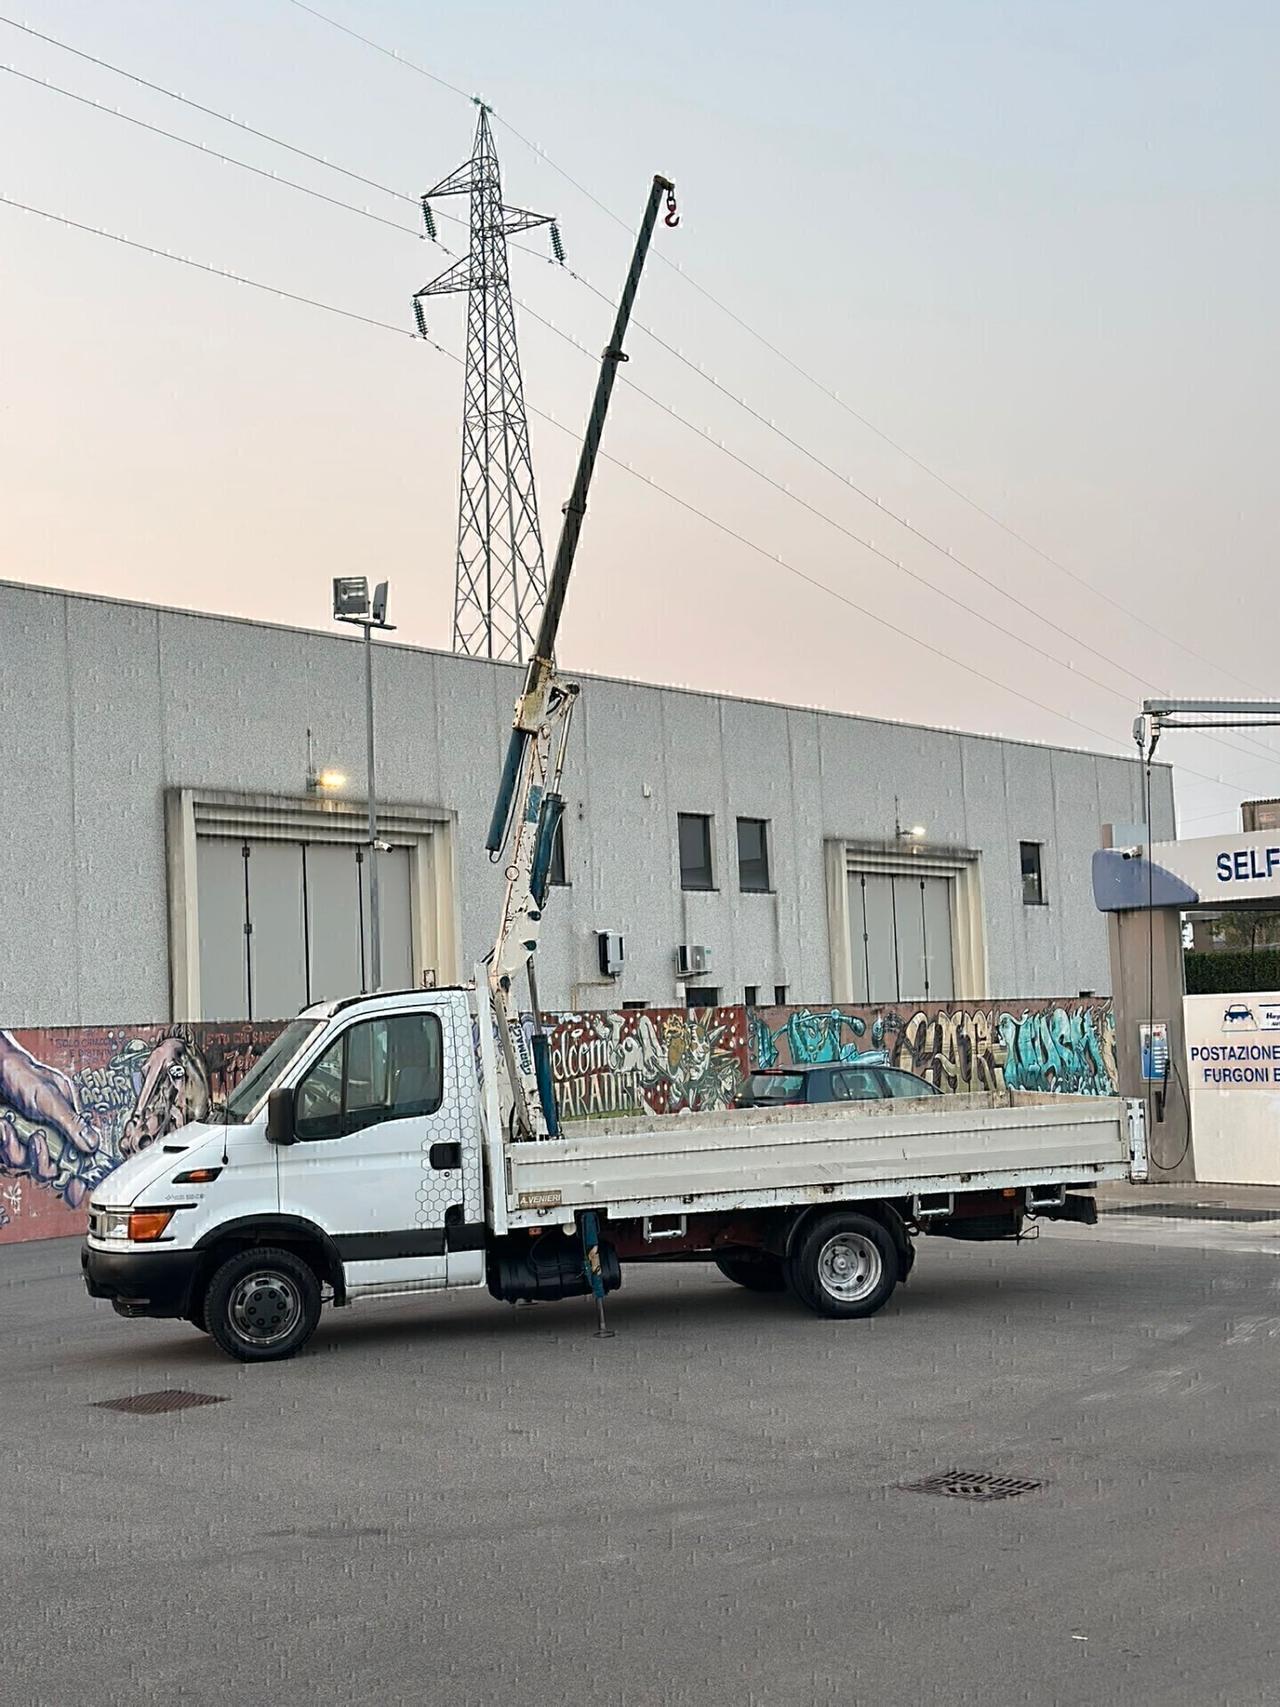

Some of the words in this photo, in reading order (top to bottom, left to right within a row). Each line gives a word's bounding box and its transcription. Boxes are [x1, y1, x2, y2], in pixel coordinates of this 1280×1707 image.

[1217, 848, 1280, 882] SELF
[549, 1030, 622, 1080] elcome
[1191, 1045, 1280, 1061] POSTAZIONE
[554, 1067, 645, 1117] ARADISE
[1204, 1067, 1269, 1083] FURGONI
